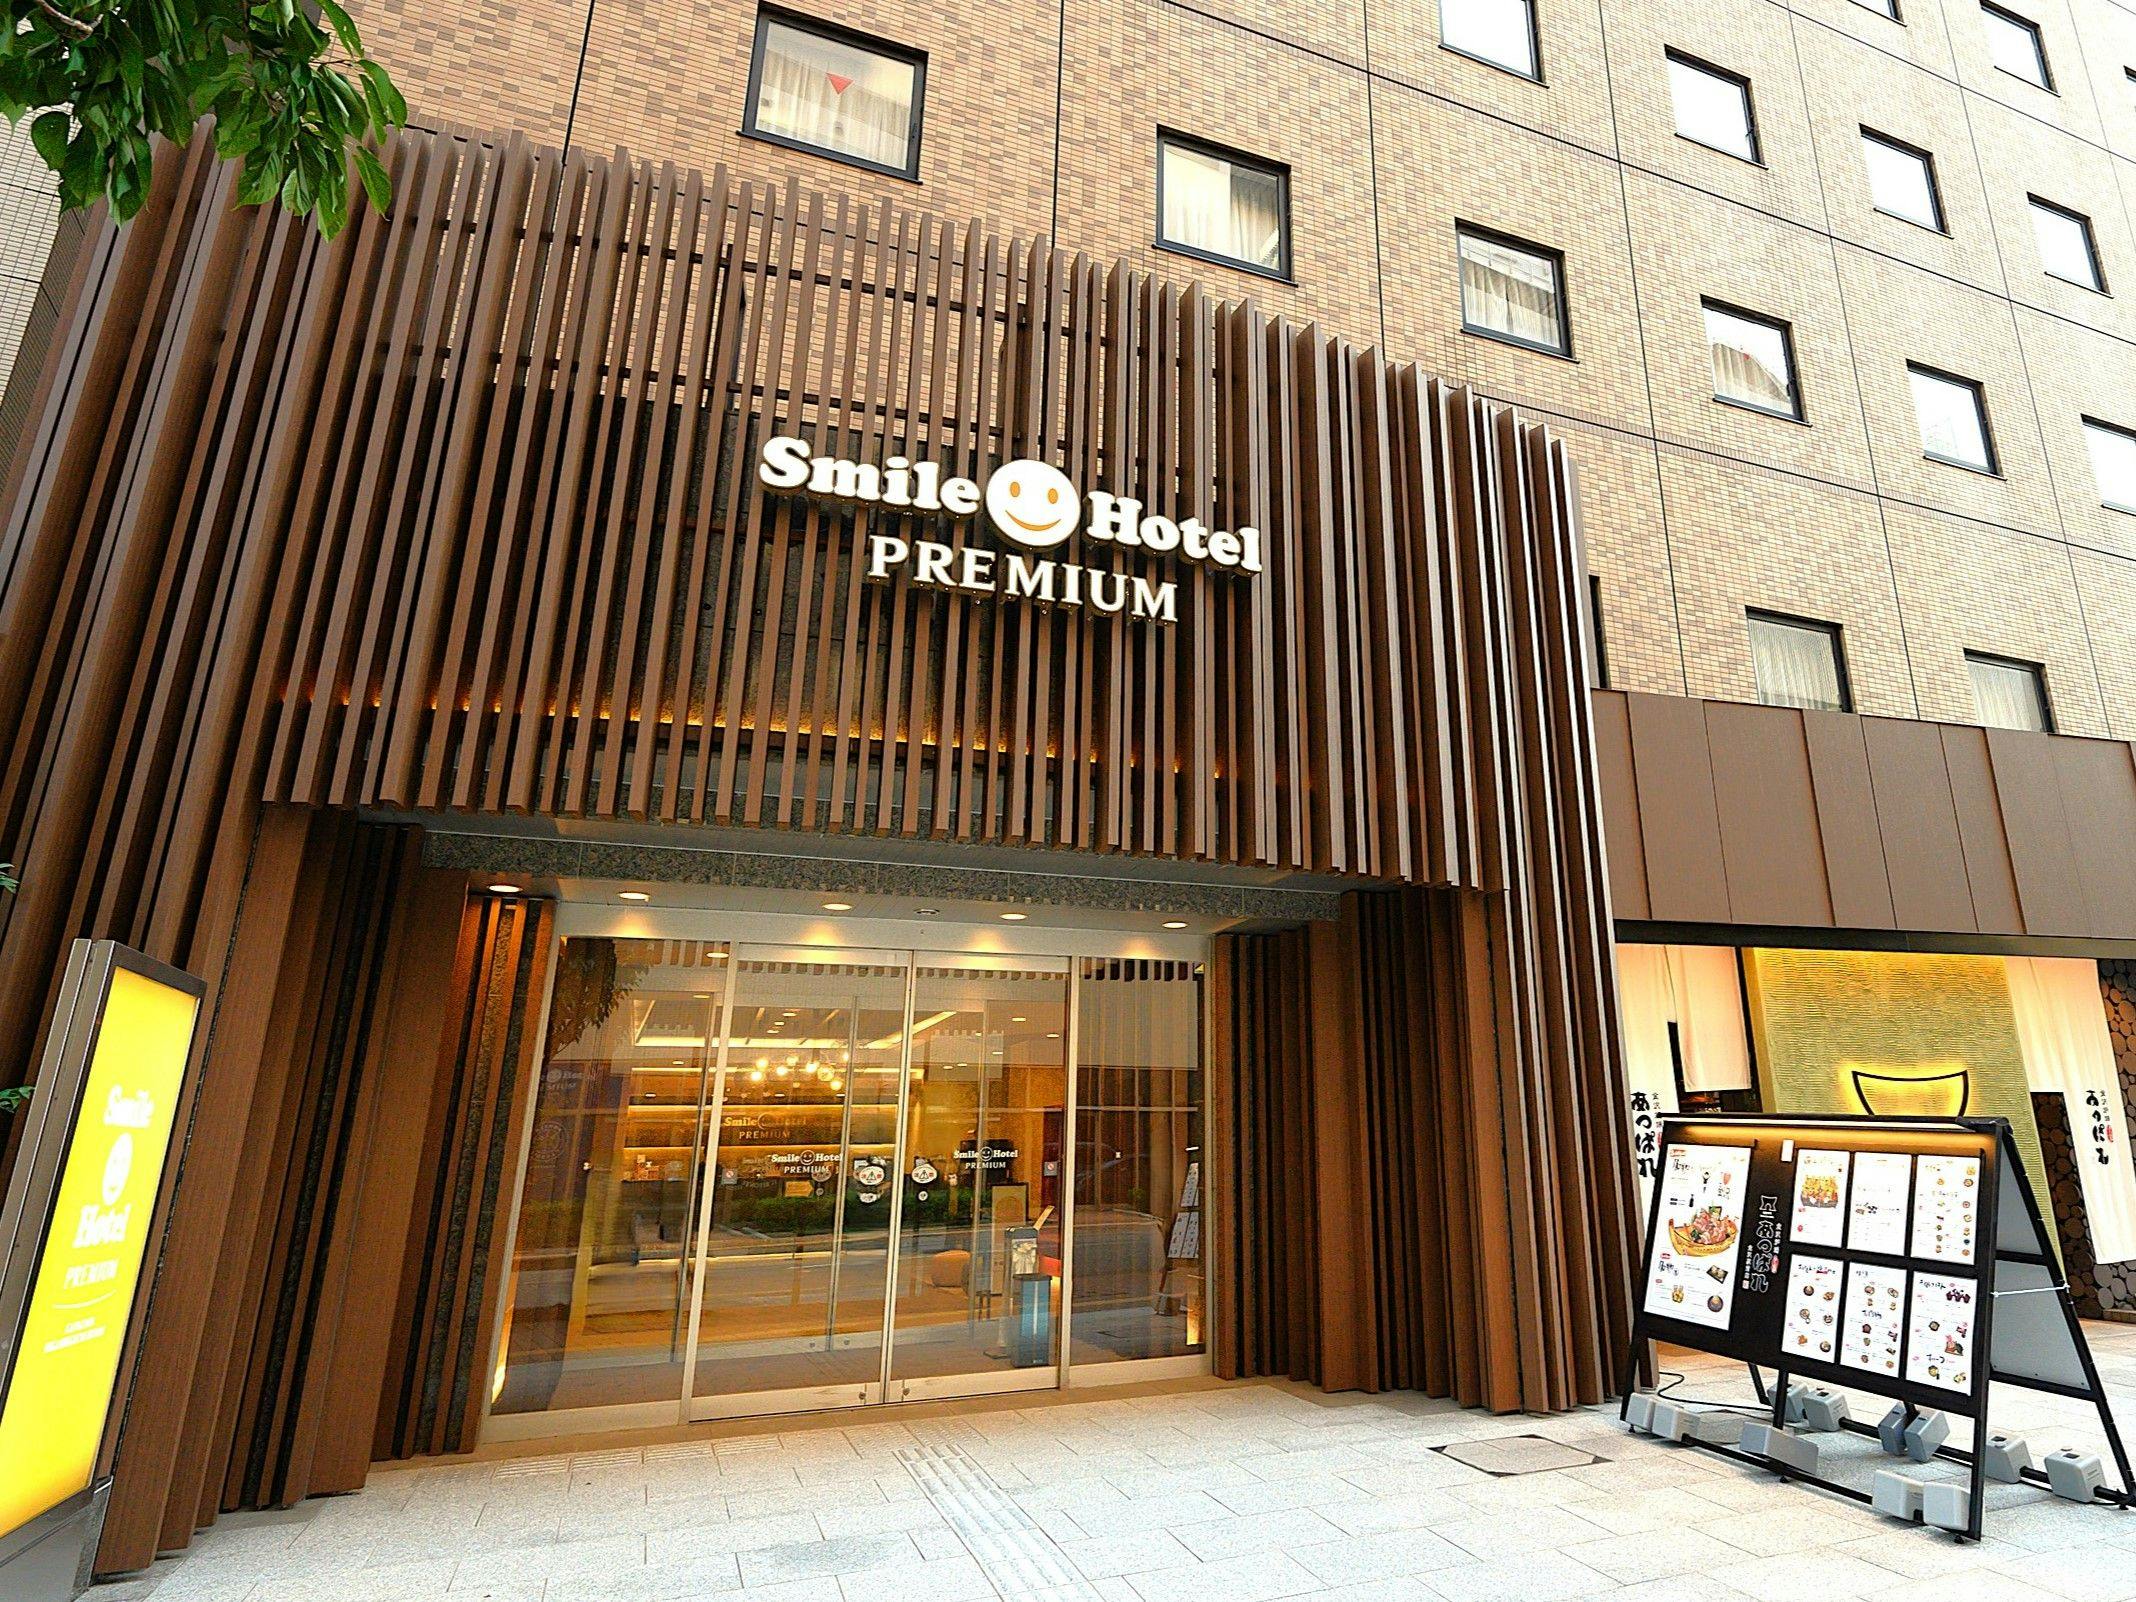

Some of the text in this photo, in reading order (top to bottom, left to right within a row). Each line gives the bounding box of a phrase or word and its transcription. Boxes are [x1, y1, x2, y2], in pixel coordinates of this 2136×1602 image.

[759, 436, 1262, 574] Smile Hotel
[868, 535, 1178, 623] PREMIUM
[103, 1084, 154, 1128] Smile
[723, 1116, 758, 1127] Smile
[739, 1130, 791, 1140] PREMIUM
[771, 1153, 800, 1163] Smile
[815, 1153, 843, 1162] Hotel
[953, 1149, 1018, 1159] Smile Hotel
[73, 1203, 131, 1249] Hotel
[64, 1259, 119, 1290] PREMIUM
